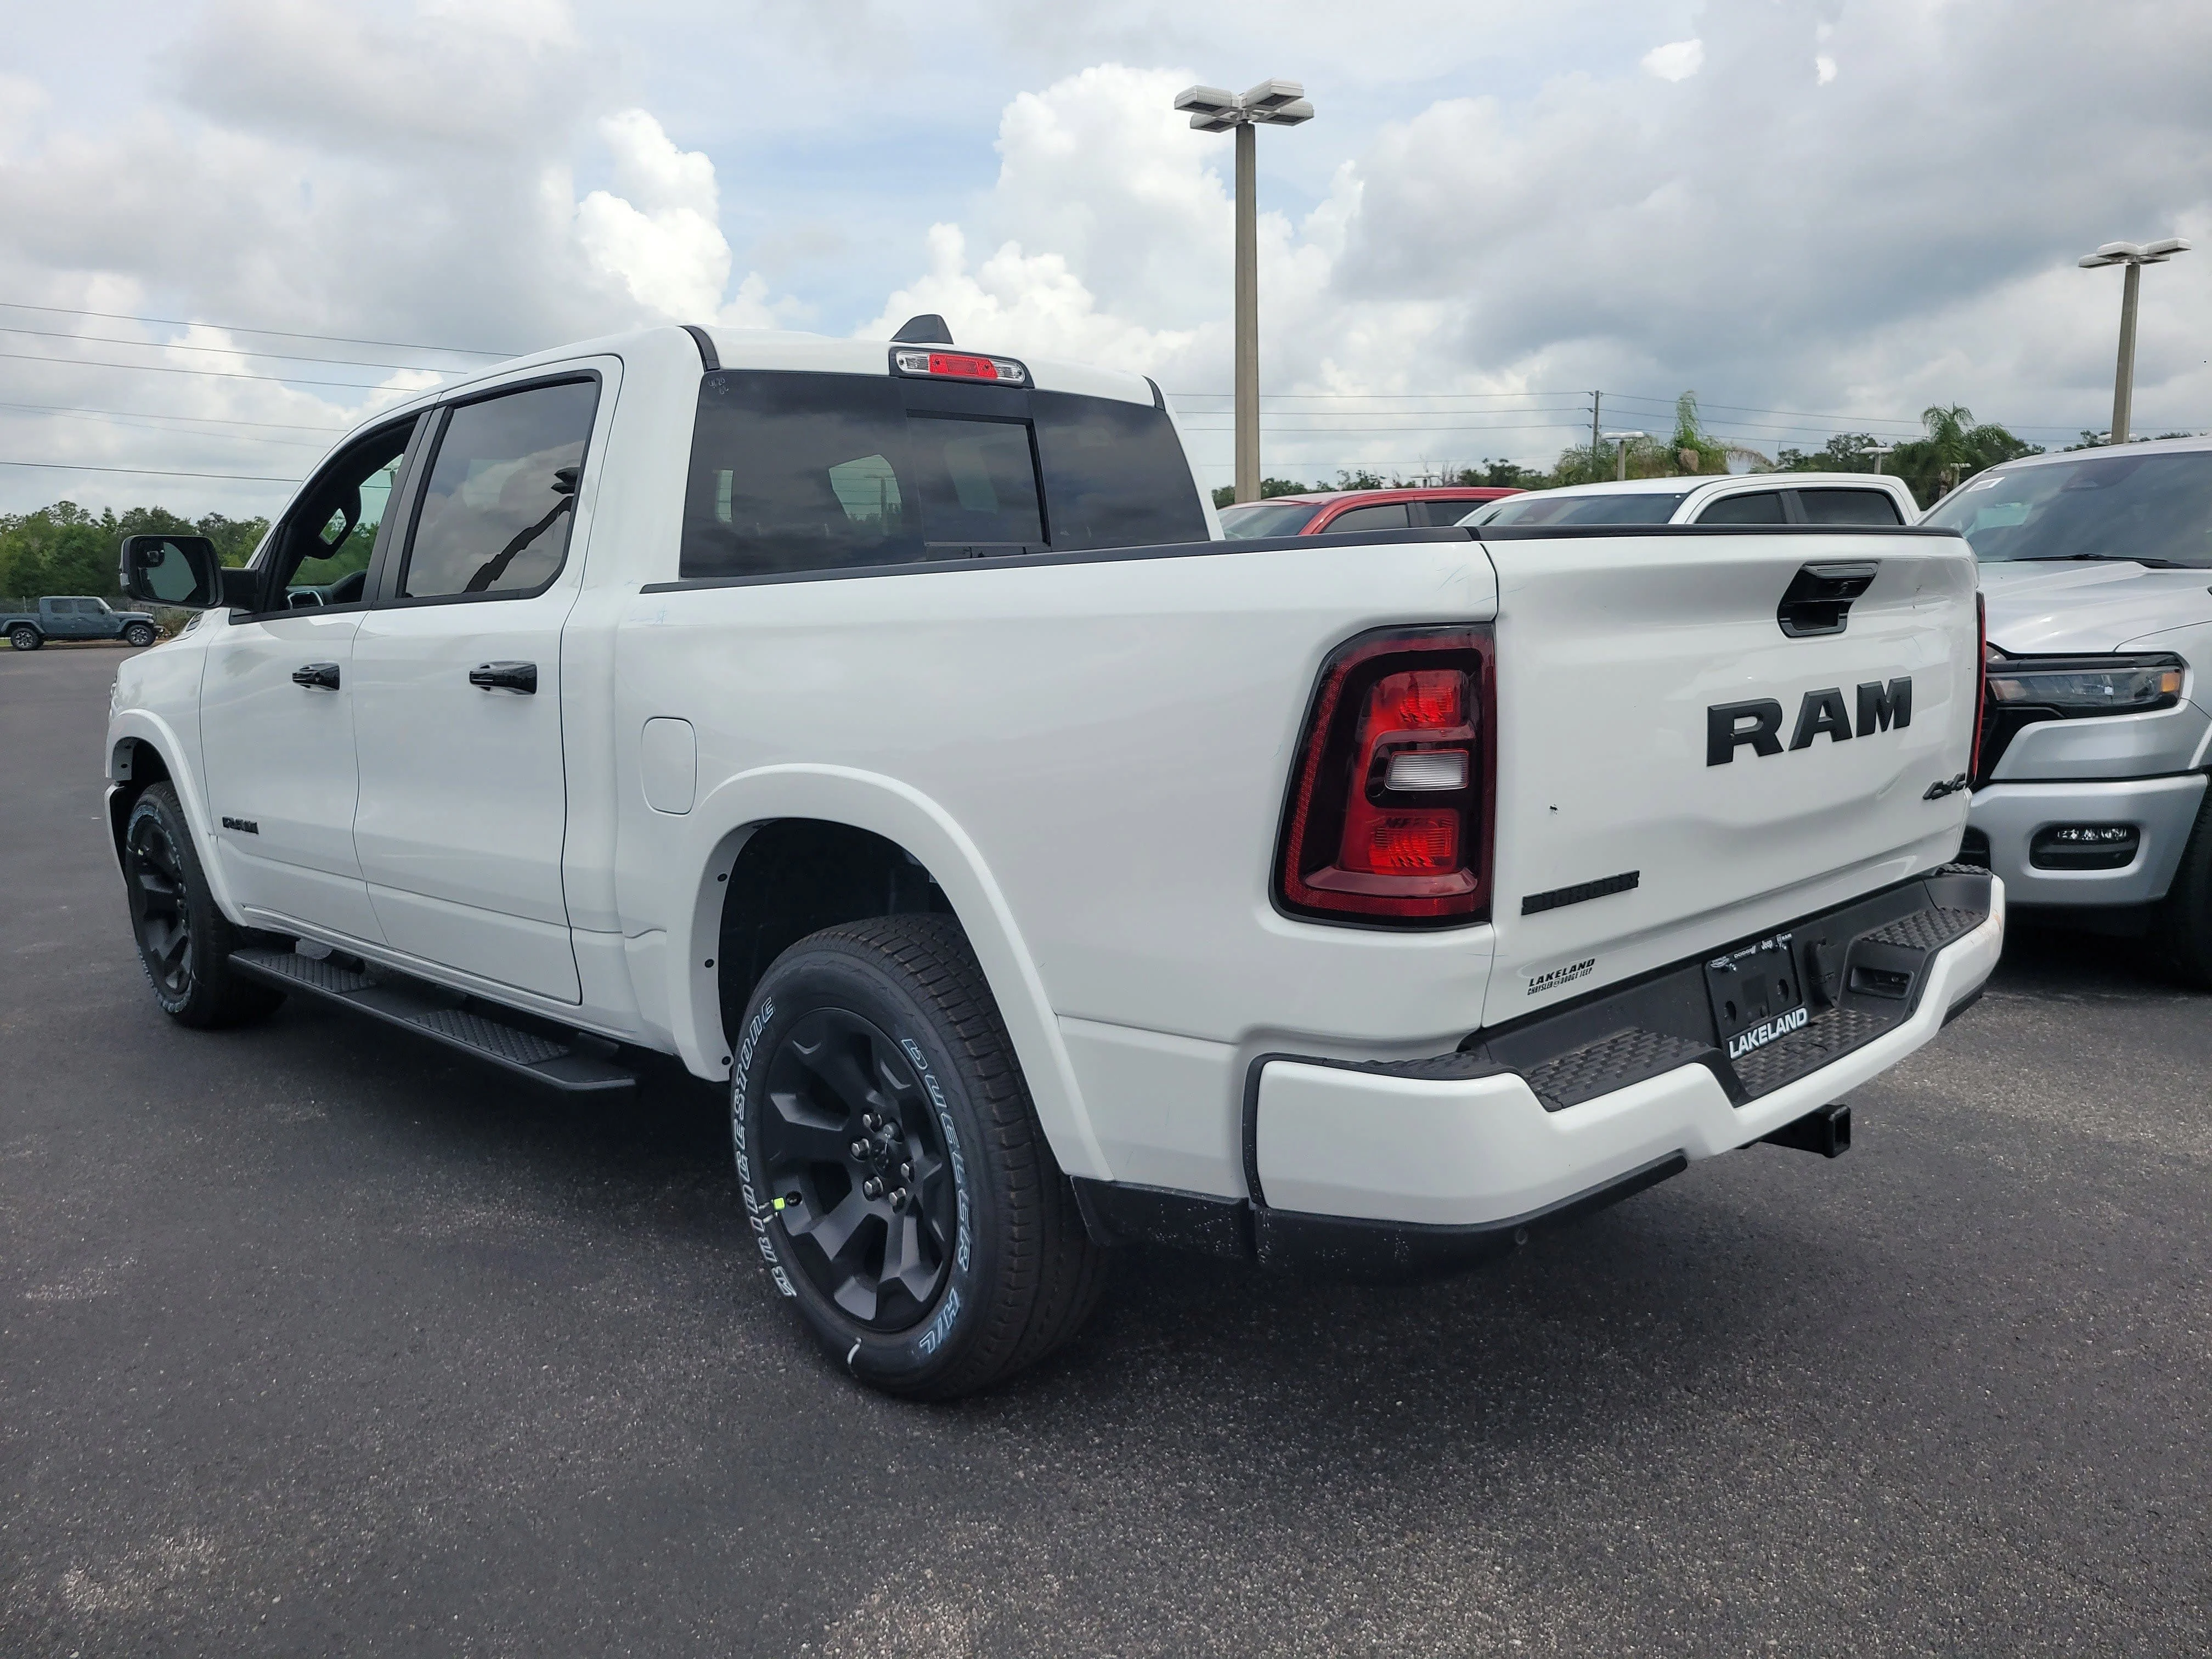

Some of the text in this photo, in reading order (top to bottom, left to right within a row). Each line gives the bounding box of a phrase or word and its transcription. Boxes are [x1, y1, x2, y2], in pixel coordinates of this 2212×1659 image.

[1706, 675, 1912, 768] RAM
[1527, 981, 1553, 995] CHRYSLER
[1580, 967, 1593, 978] JEEP
[1528, 958, 1595, 987] LAKELAND
[1729, 1007, 1808, 1059] LAKELAND
[734, 996, 797, 1297] BRIDGESTONE
[901, 1039, 971, 1353] DUELER H/L
